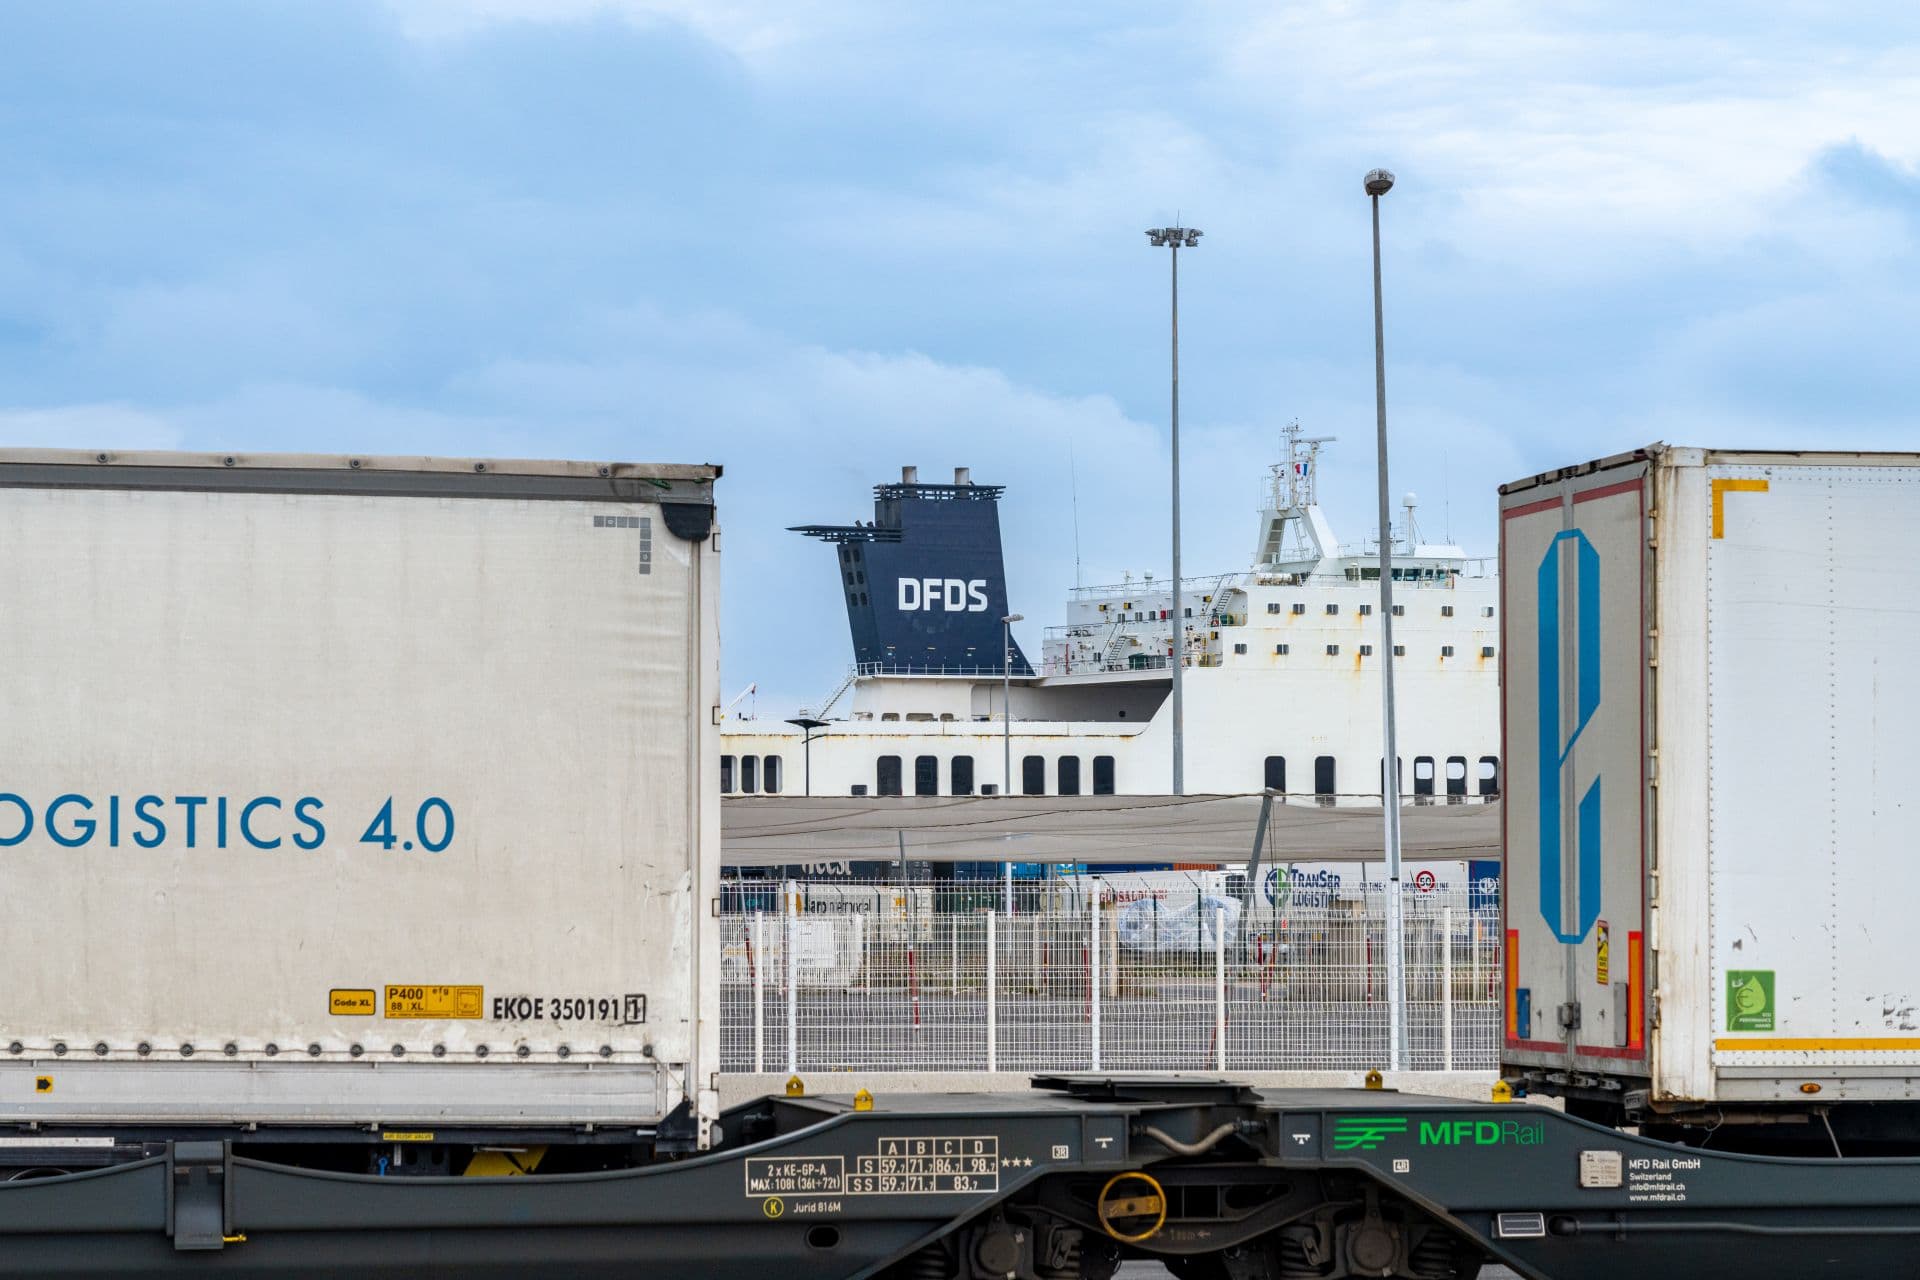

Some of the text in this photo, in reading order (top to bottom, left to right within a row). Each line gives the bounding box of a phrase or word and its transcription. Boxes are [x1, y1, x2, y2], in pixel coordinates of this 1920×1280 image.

[898, 578, 988, 612] DFDS
[0, 793, 455, 852] OGISTICS 4.0
[1420, 877, 1431, 887] 50
[389, 988, 423, 999] P400
[391, 1002, 423, 1010] 88 XL
[493, 998, 543, 1020] EKOE
[550, 998, 618, 1020] 350191
[888, 1140, 983, 1155] A B C D
[768, 1163, 827, 1177] 2 x KE-GP-A
[864, 1158, 996, 1174] S 59.7 71.7 86.7 98.7
[1629, 1159, 1701, 1169] MFD Rail GmbH
[775, 1177, 796, 1190] 108t
[797, 1174, 841, 1190] (36t+72t)
[881, 1177, 906, 1192] 59.7
[909, 1177, 933, 1192] 71.7
[953, 1176, 978, 1191] 83.7
[1629, 1173, 1672, 1181] Switzerland
[1629, 1183, 1686, 1191] info@mfdrail.ch
[793, 1202, 816, 1213] Jurid
[818, 1201, 841, 1212] 816M
